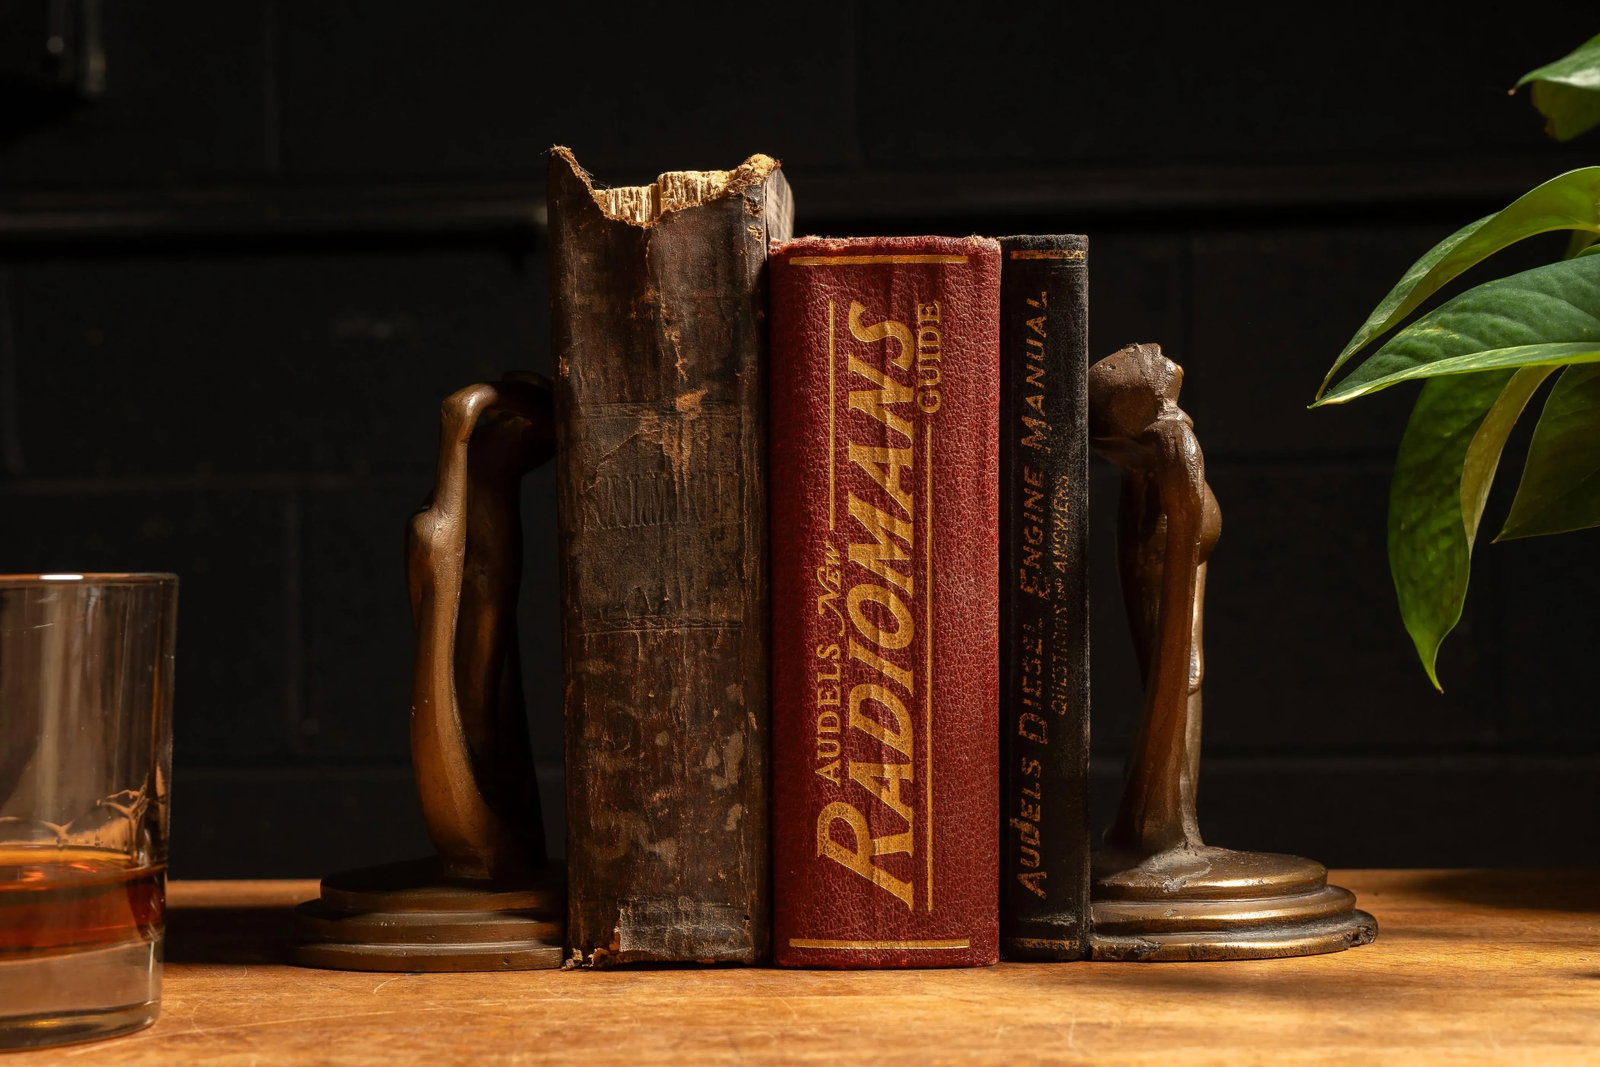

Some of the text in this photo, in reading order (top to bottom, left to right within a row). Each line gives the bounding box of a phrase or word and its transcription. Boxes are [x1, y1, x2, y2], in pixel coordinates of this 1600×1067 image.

[917, 300, 943, 414] GUIDE
[1016, 290, 1053, 900] AUDELS DIESEL ENGINE MANUAL
[1052, 474, 1070, 574] ANSWERS
[816, 299, 915, 912] RADIOMANS
[815, 643, 842, 787] AUDELS
